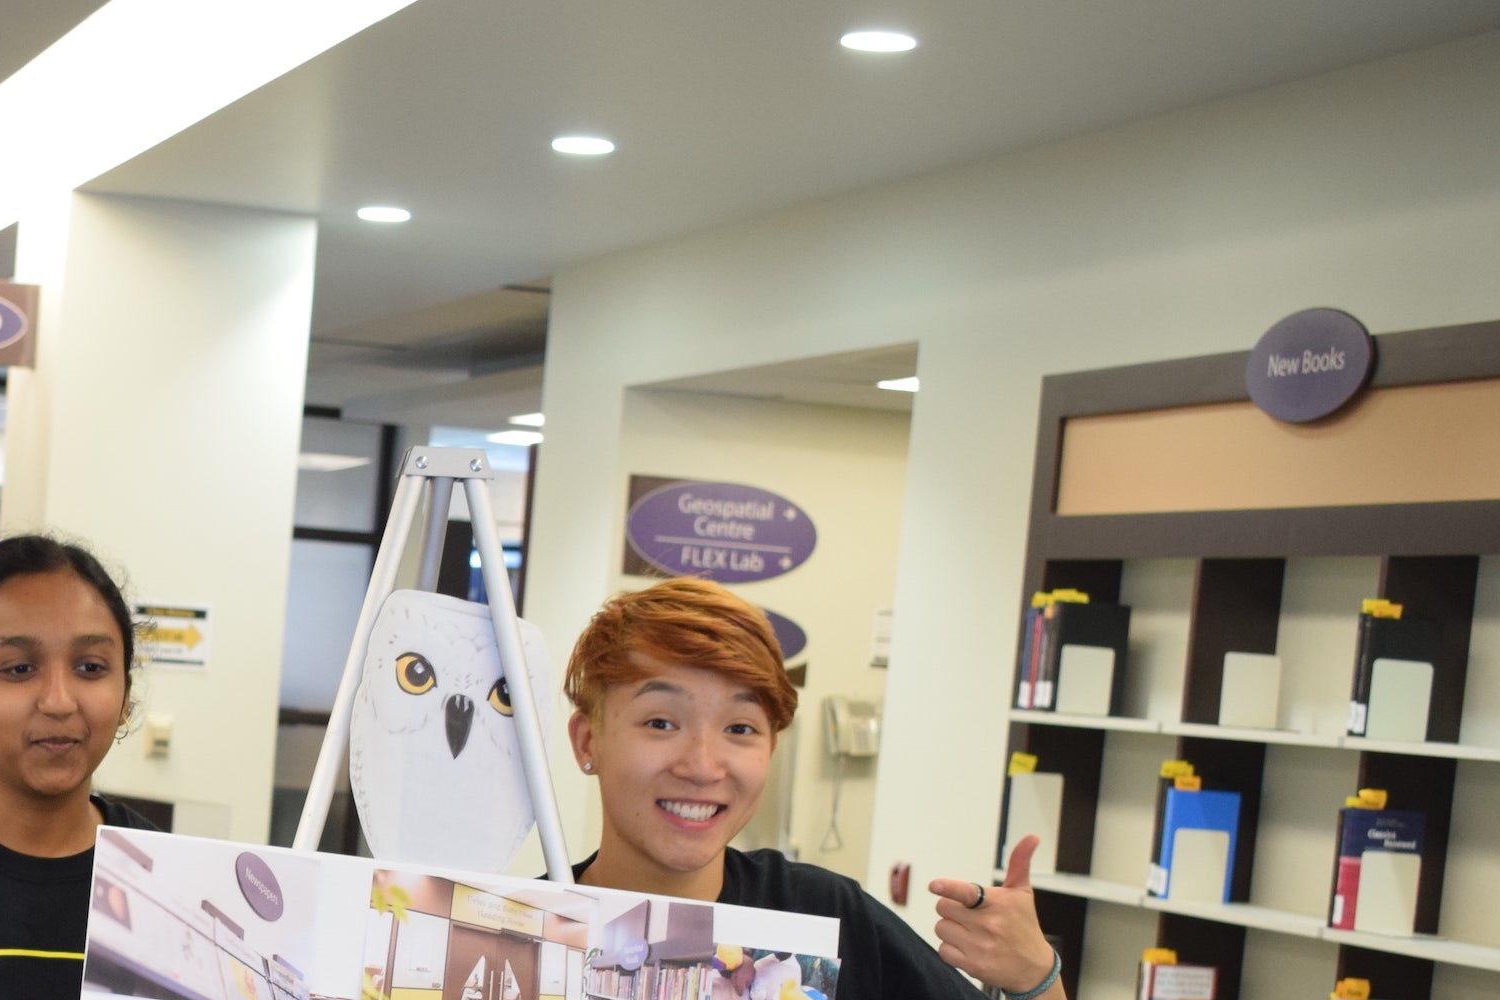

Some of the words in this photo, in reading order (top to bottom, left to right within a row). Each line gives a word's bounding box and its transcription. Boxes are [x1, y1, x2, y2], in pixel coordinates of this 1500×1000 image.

[1267, 354, 1300, 378] New
[1301, 346, 1346, 375] Books
[677, 493, 776, 522] Geospatial
[694, 516, 756, 541] Centre
[680, 545, 727, 570] FLEX
[730, 548, 766, 573] Lab
